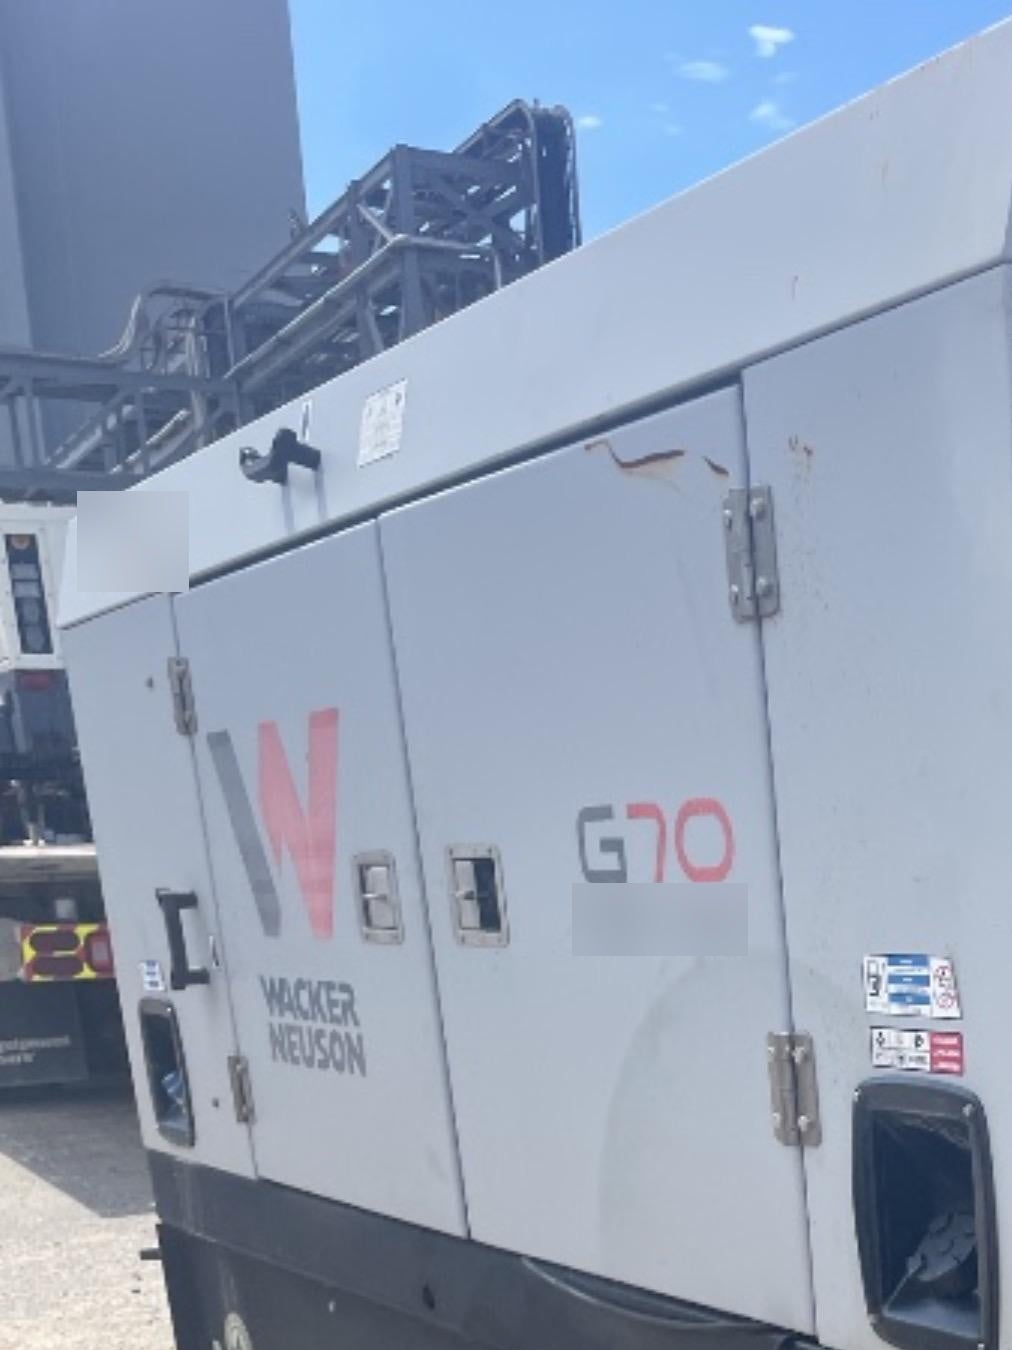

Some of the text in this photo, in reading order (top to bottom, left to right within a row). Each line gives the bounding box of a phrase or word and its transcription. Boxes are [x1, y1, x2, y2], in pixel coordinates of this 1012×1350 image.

[576, 797, 736, 884] G70
[259, 975, 360, 1027] WACKER
[268, 1022, 367, 1078] NEUSON
